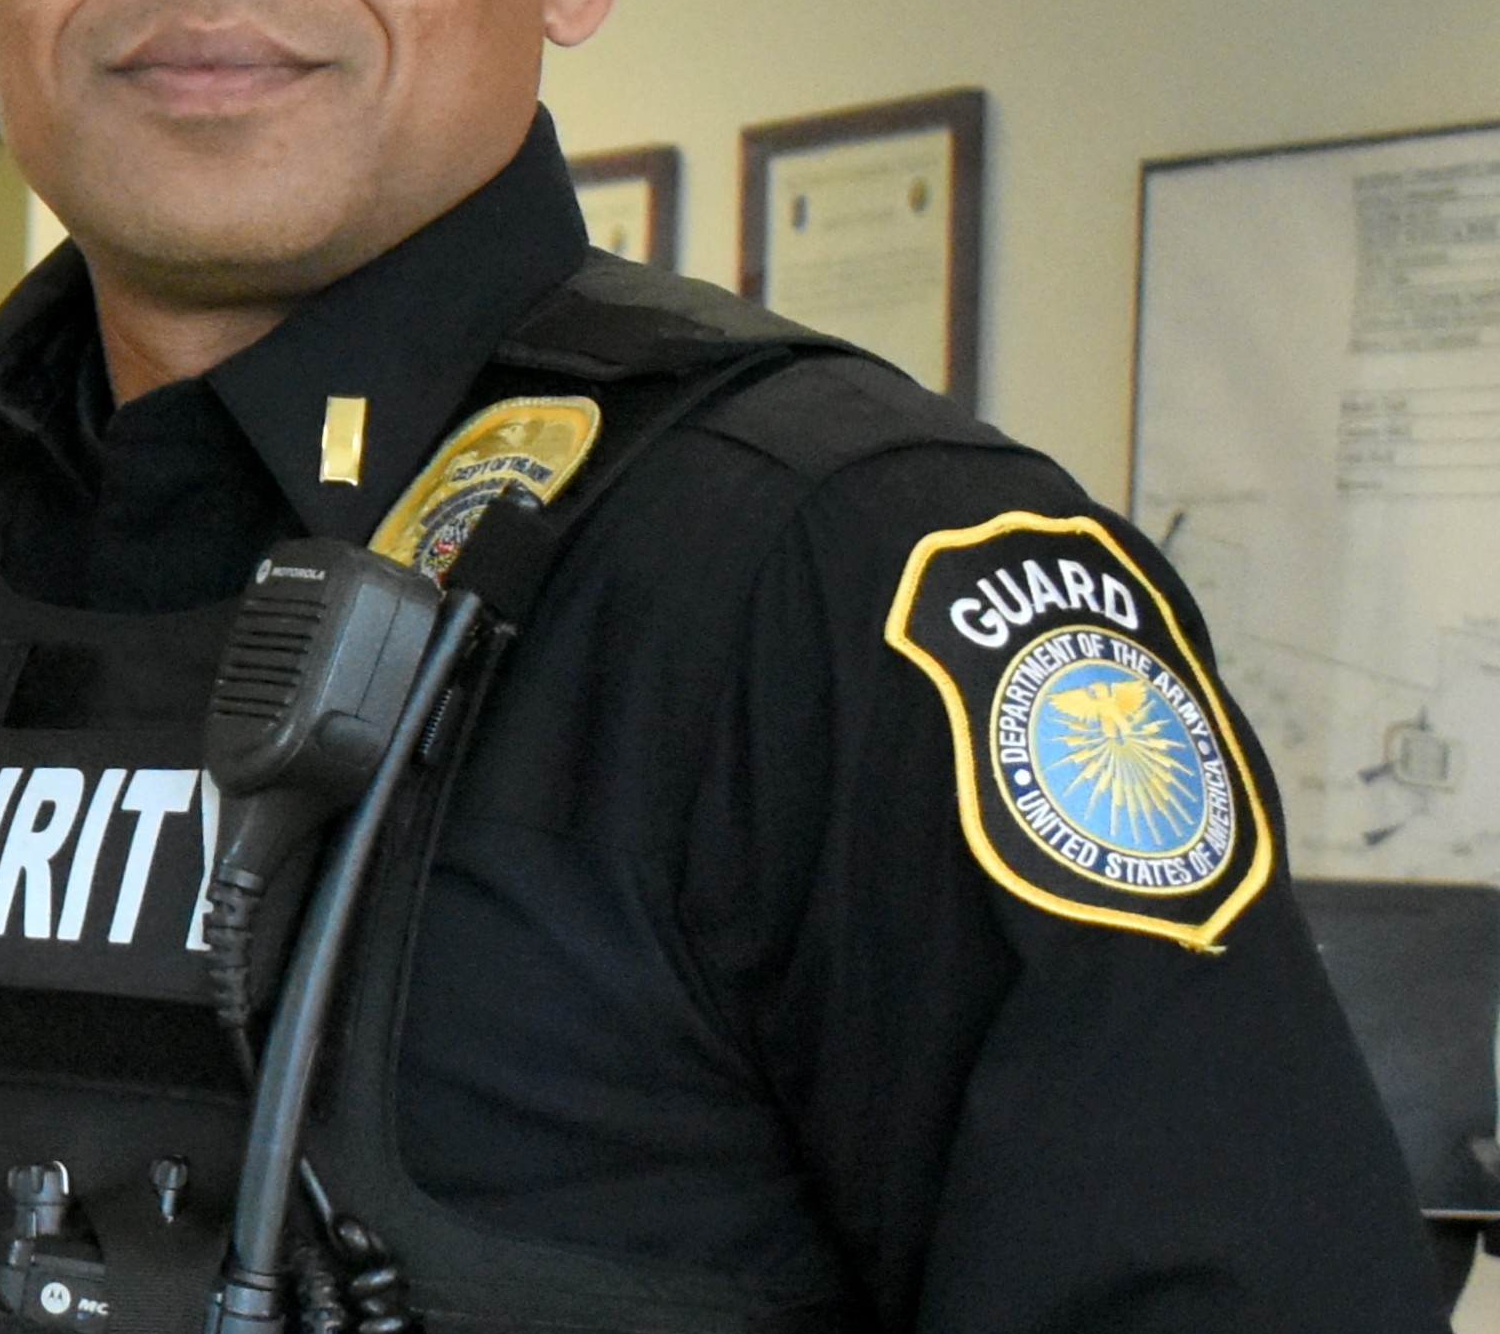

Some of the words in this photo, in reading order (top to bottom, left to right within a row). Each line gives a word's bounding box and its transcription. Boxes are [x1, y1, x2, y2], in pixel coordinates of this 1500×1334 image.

[950, 559, 1140, 649] GUARD
[1000, 632, 1076, 764] DEPARTMENT
[1076, 632, 1105, 659] OF
[1109, 638, 1154, 680] THE
[1151, 671, 1211, 739] ARMY
[1015, 789, 1101, 869] UNITED
[1104, 852, 1193, 887] STATES
[1188, 841, 1215, 878] OF
[1203, 755, 1231, 860] AMERICA
